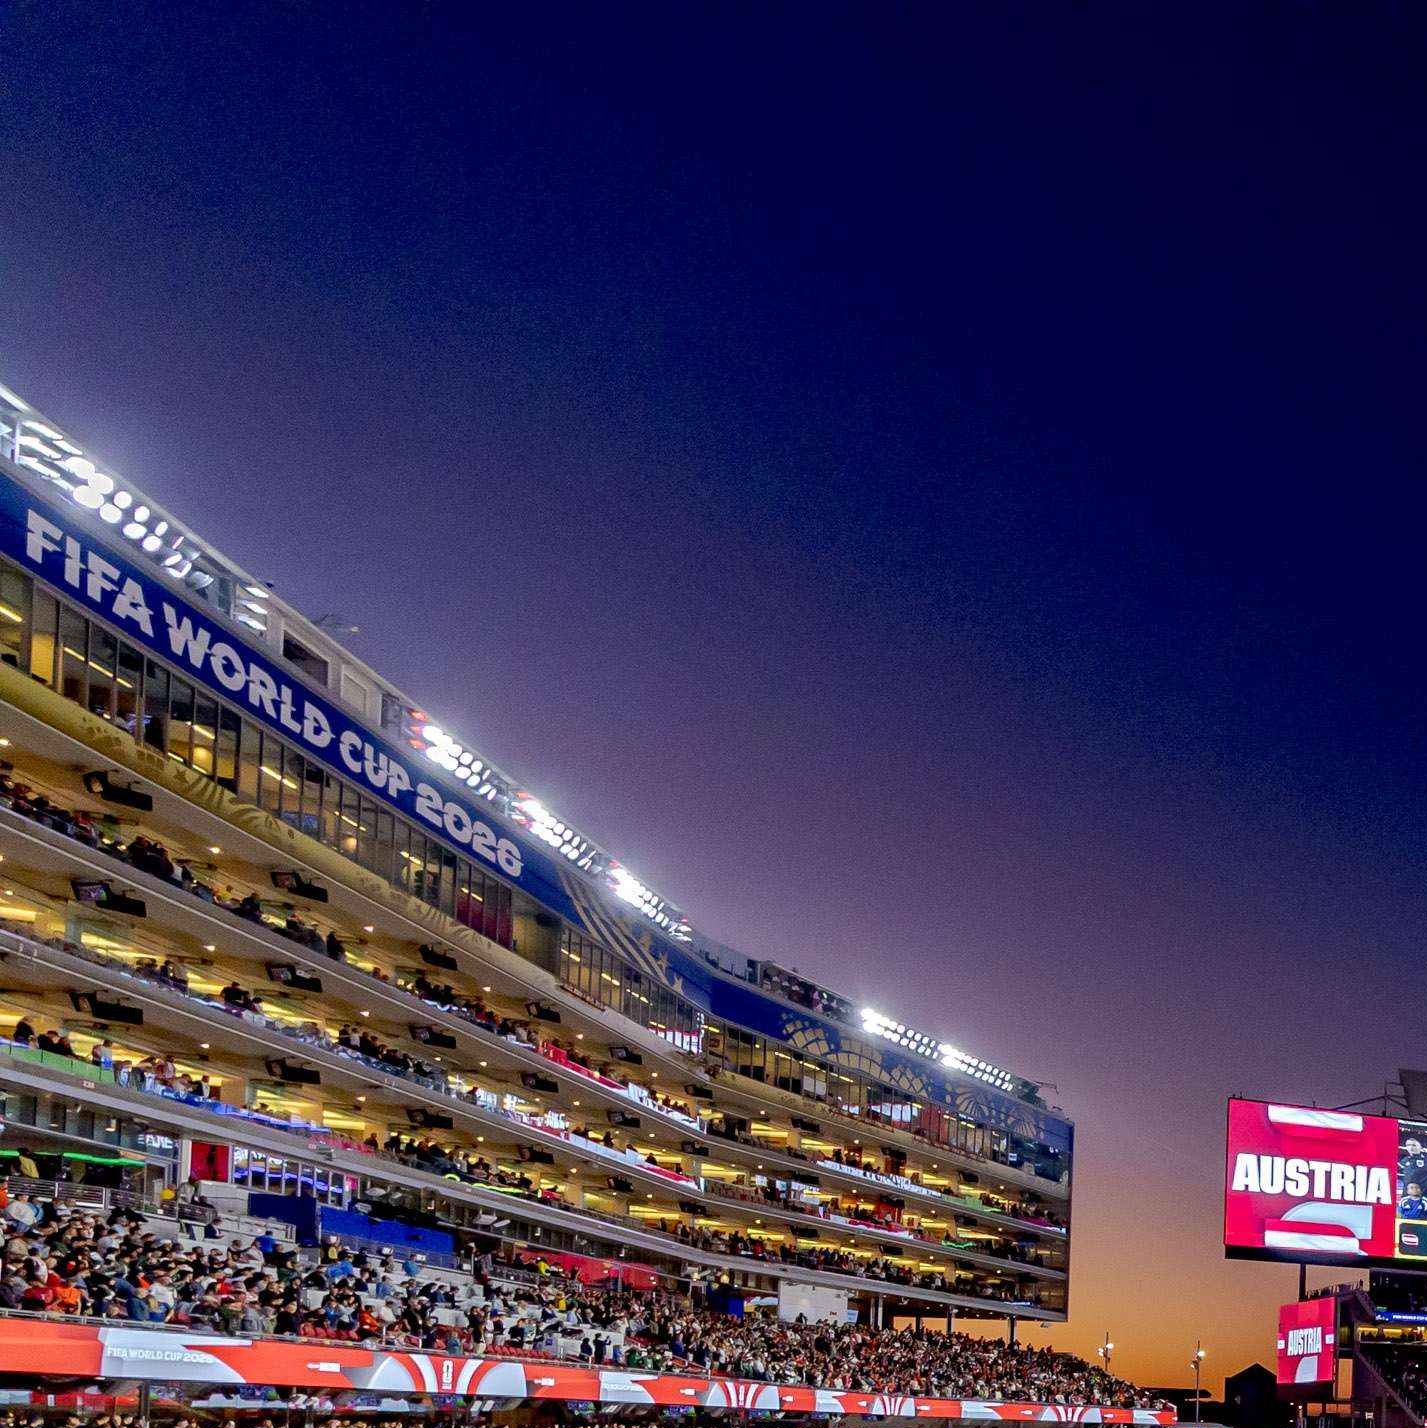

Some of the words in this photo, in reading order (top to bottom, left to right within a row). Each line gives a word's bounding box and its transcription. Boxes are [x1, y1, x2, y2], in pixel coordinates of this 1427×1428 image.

[26, 509, 153, 637] FIFA
[162, 602, 336, 748] WORLD
[339, 731, 412, 798] CUP
[416, 783, 523, 877] 2026
[1232, 1153, 1392, 1204] AUSTRIA
[130, 1348, 163, 1360] WORLD
[164, 1351, 182, 1361] CUP
[1287, 1327, 1322, 1356] AUSTRIA
